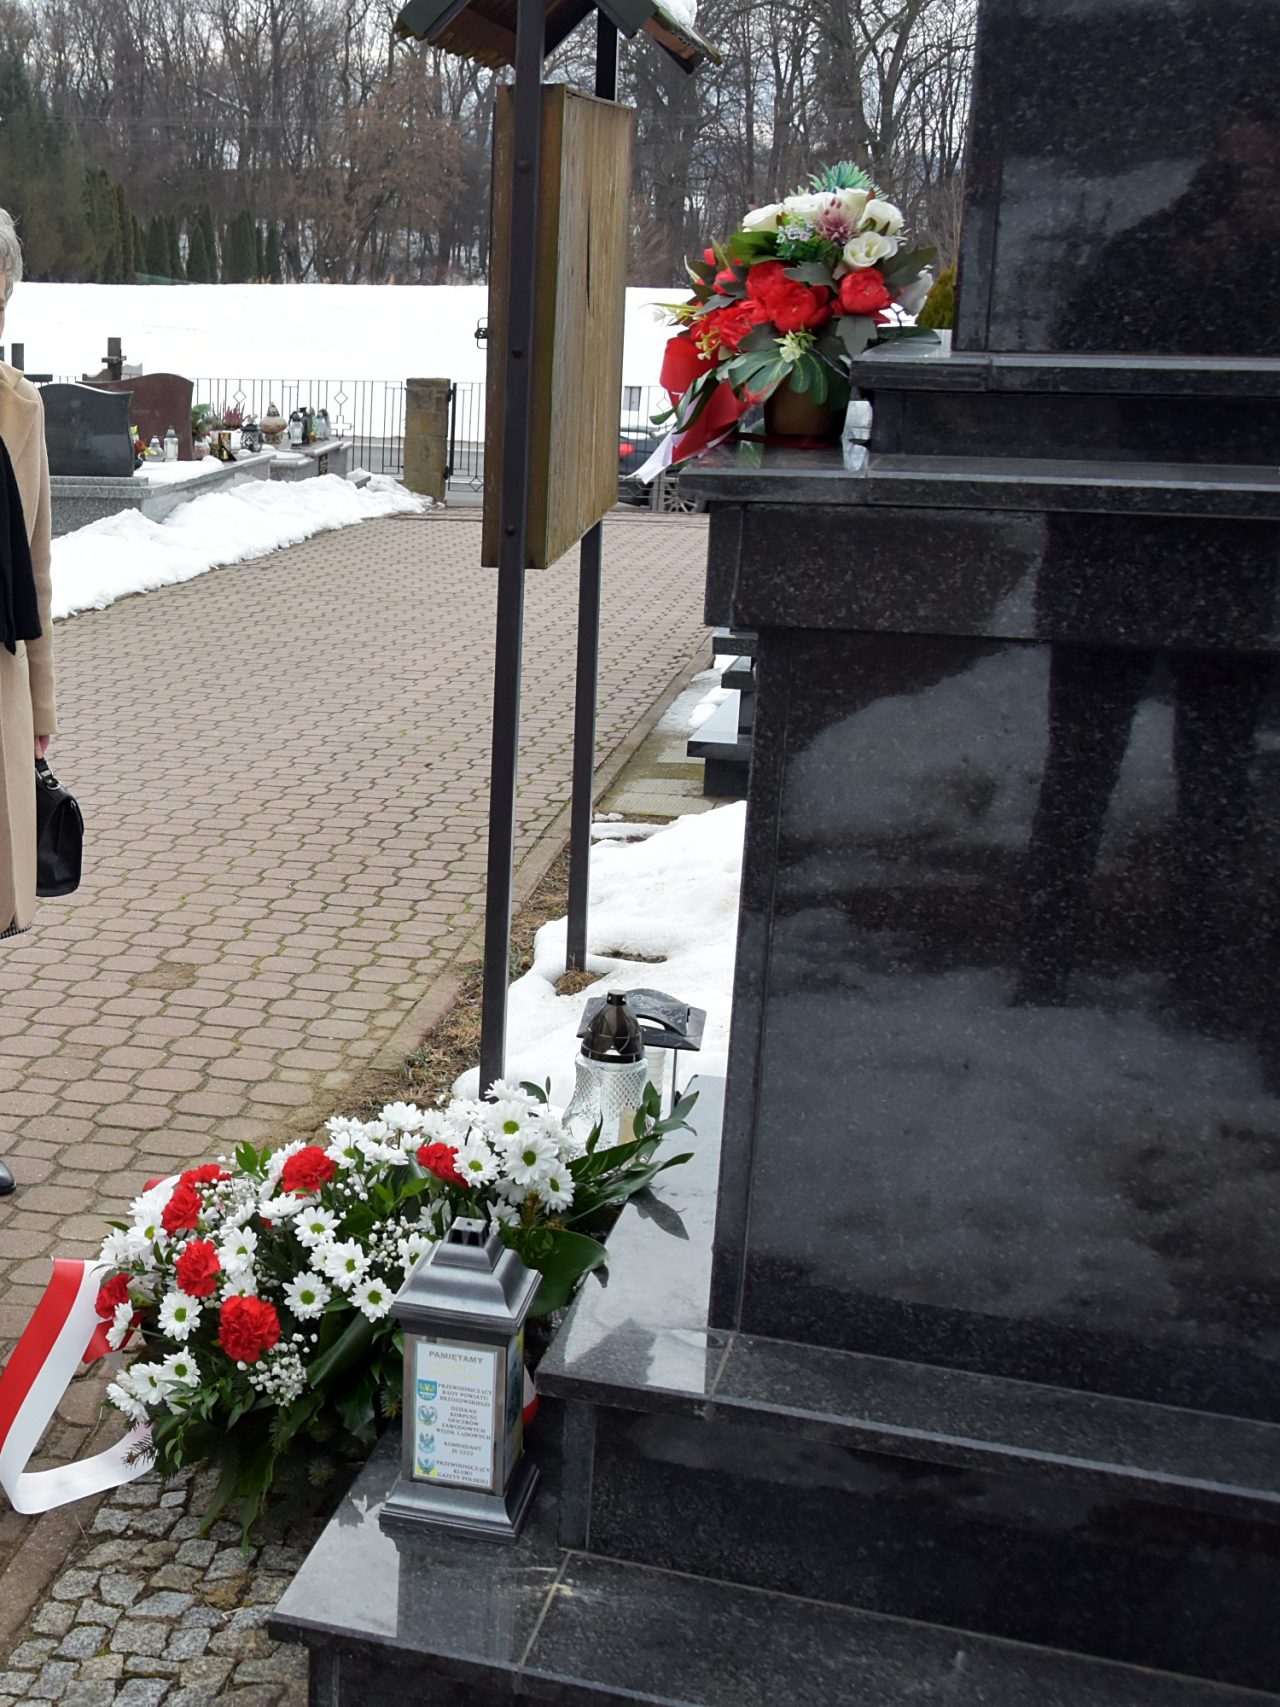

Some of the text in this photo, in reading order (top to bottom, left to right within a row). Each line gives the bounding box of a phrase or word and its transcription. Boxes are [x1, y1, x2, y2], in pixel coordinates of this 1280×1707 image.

[428, 1350, 484, 1364] PAMIĘTAMY
[442, 1389, 489, 1401] RADY POWIATU
[444, 1441, 482, 1451] KOMENDANT
[437, 1472, 489, 1485] GAZETY POLSKIEJ
